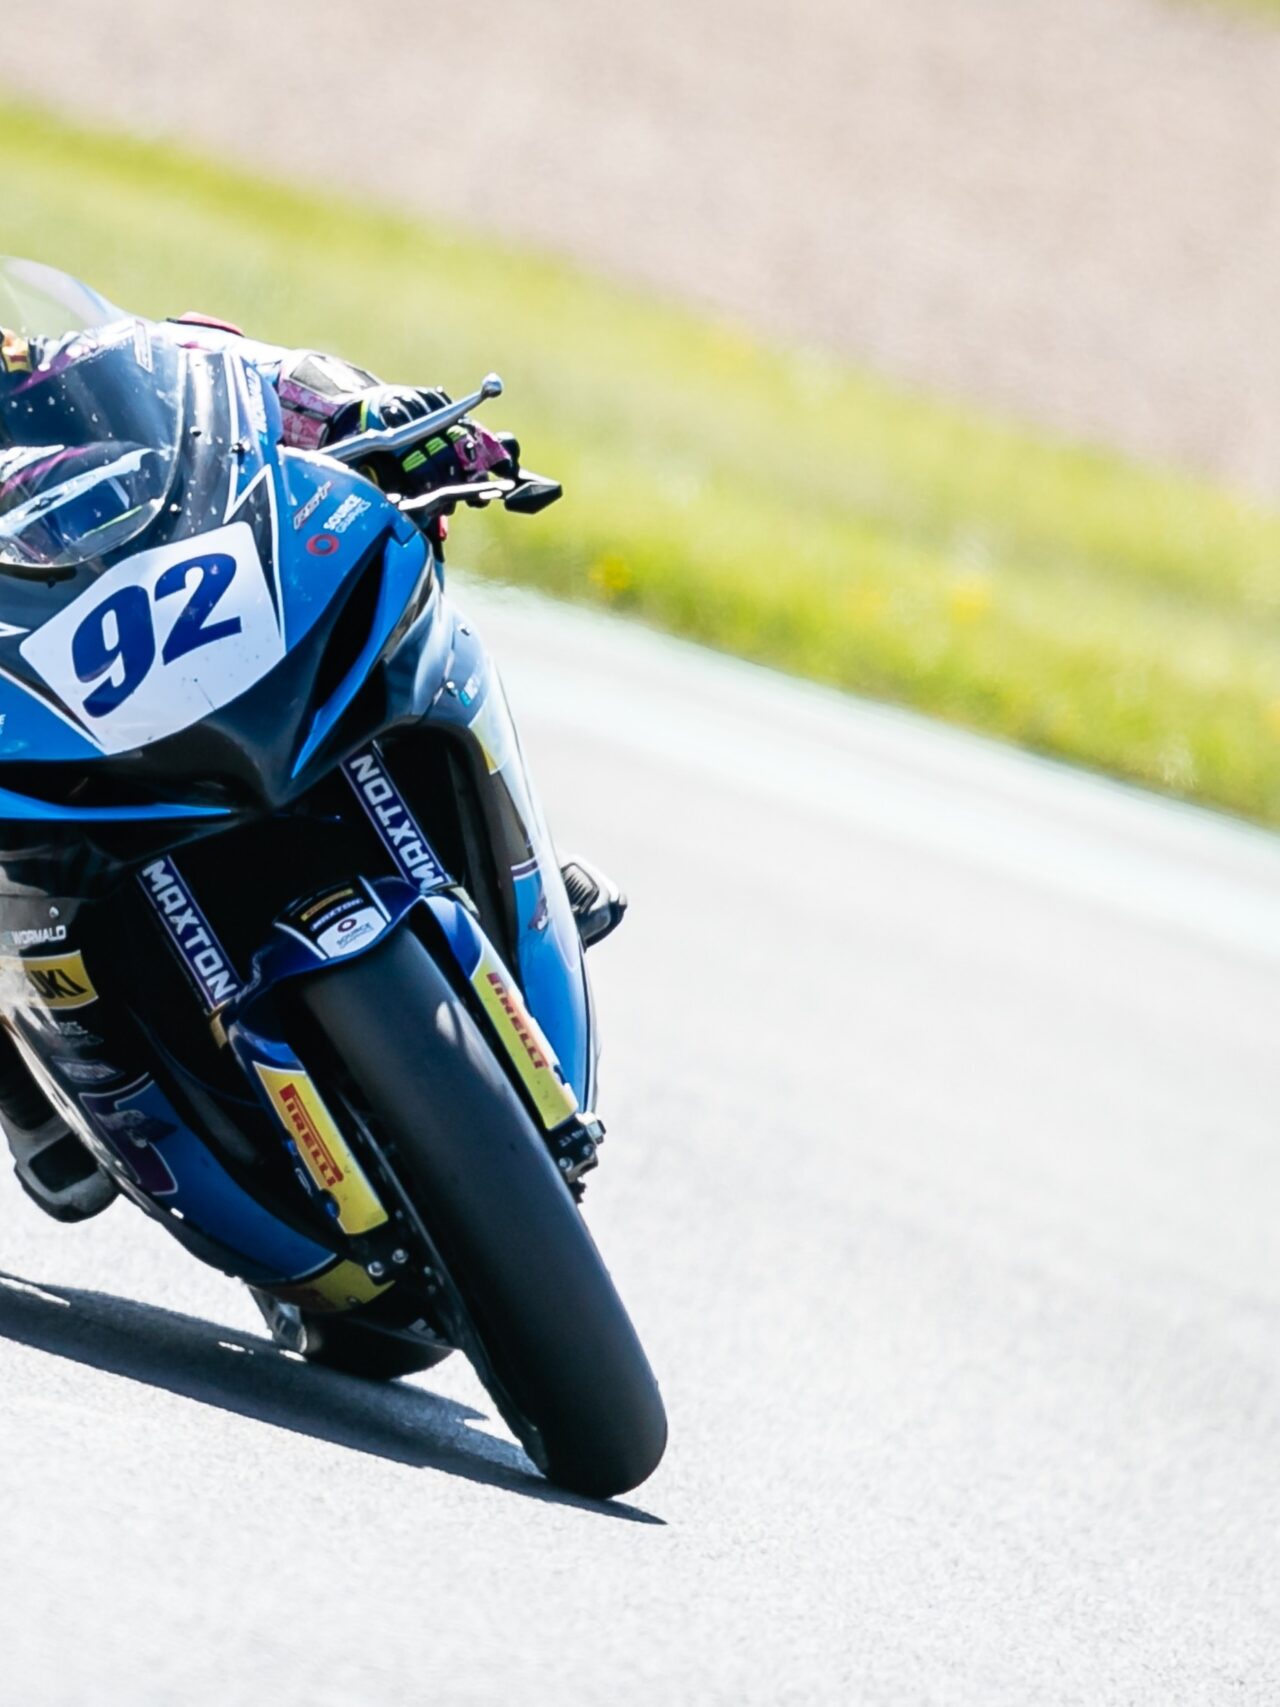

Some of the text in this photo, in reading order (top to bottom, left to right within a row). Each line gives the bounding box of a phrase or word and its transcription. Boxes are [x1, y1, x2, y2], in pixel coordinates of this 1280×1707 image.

[71, 552, 243, 719] 92
[349, 753, 445, 889] MAXTON
[142, 859, 238, 1001] MAXTON
[279, 1083, 344, 1187] PIRELLI
